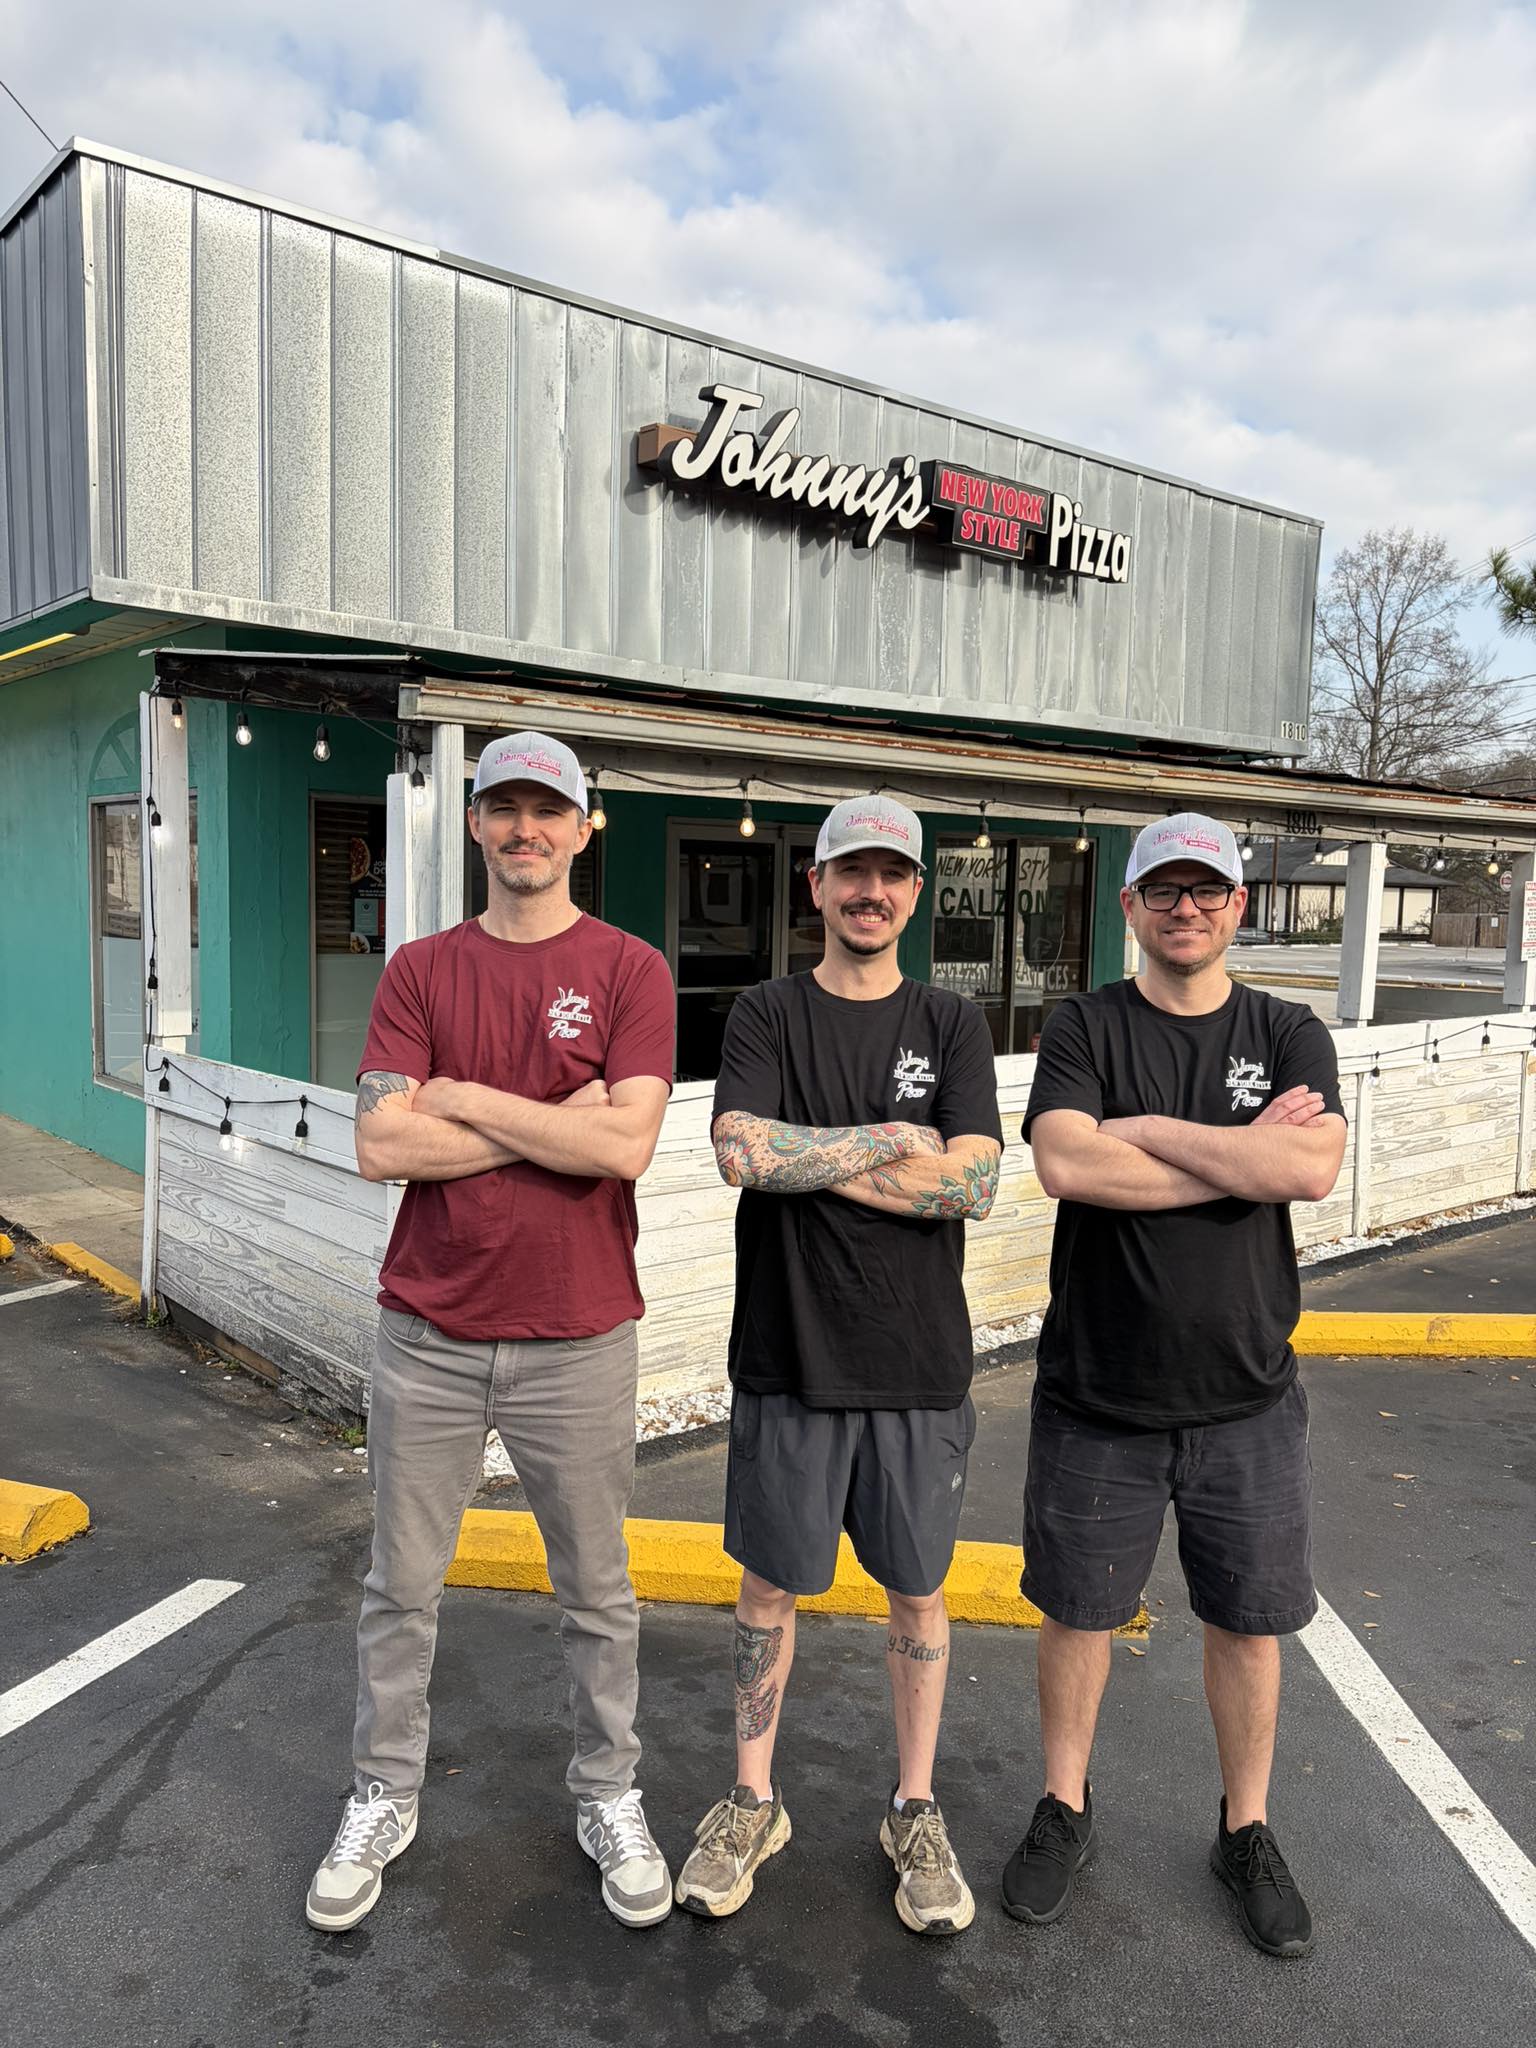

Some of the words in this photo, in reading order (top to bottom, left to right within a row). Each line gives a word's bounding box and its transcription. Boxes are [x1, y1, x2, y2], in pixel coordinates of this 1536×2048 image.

[671, 384, 930, 548] Johnny's
[940, 470, 989, 504] NEW
[989, 482, 1044, 525] YORK
[960, 510, 1020, 552] STYLE
[1049, 493, 1132, 583] Pizza
[1283, 722, 1306, 741] 1810
[1285, 811, 1317, 835] 1810
[936, 855, 968, 877] NEW
[967, 857, 1008, 878] YORK
